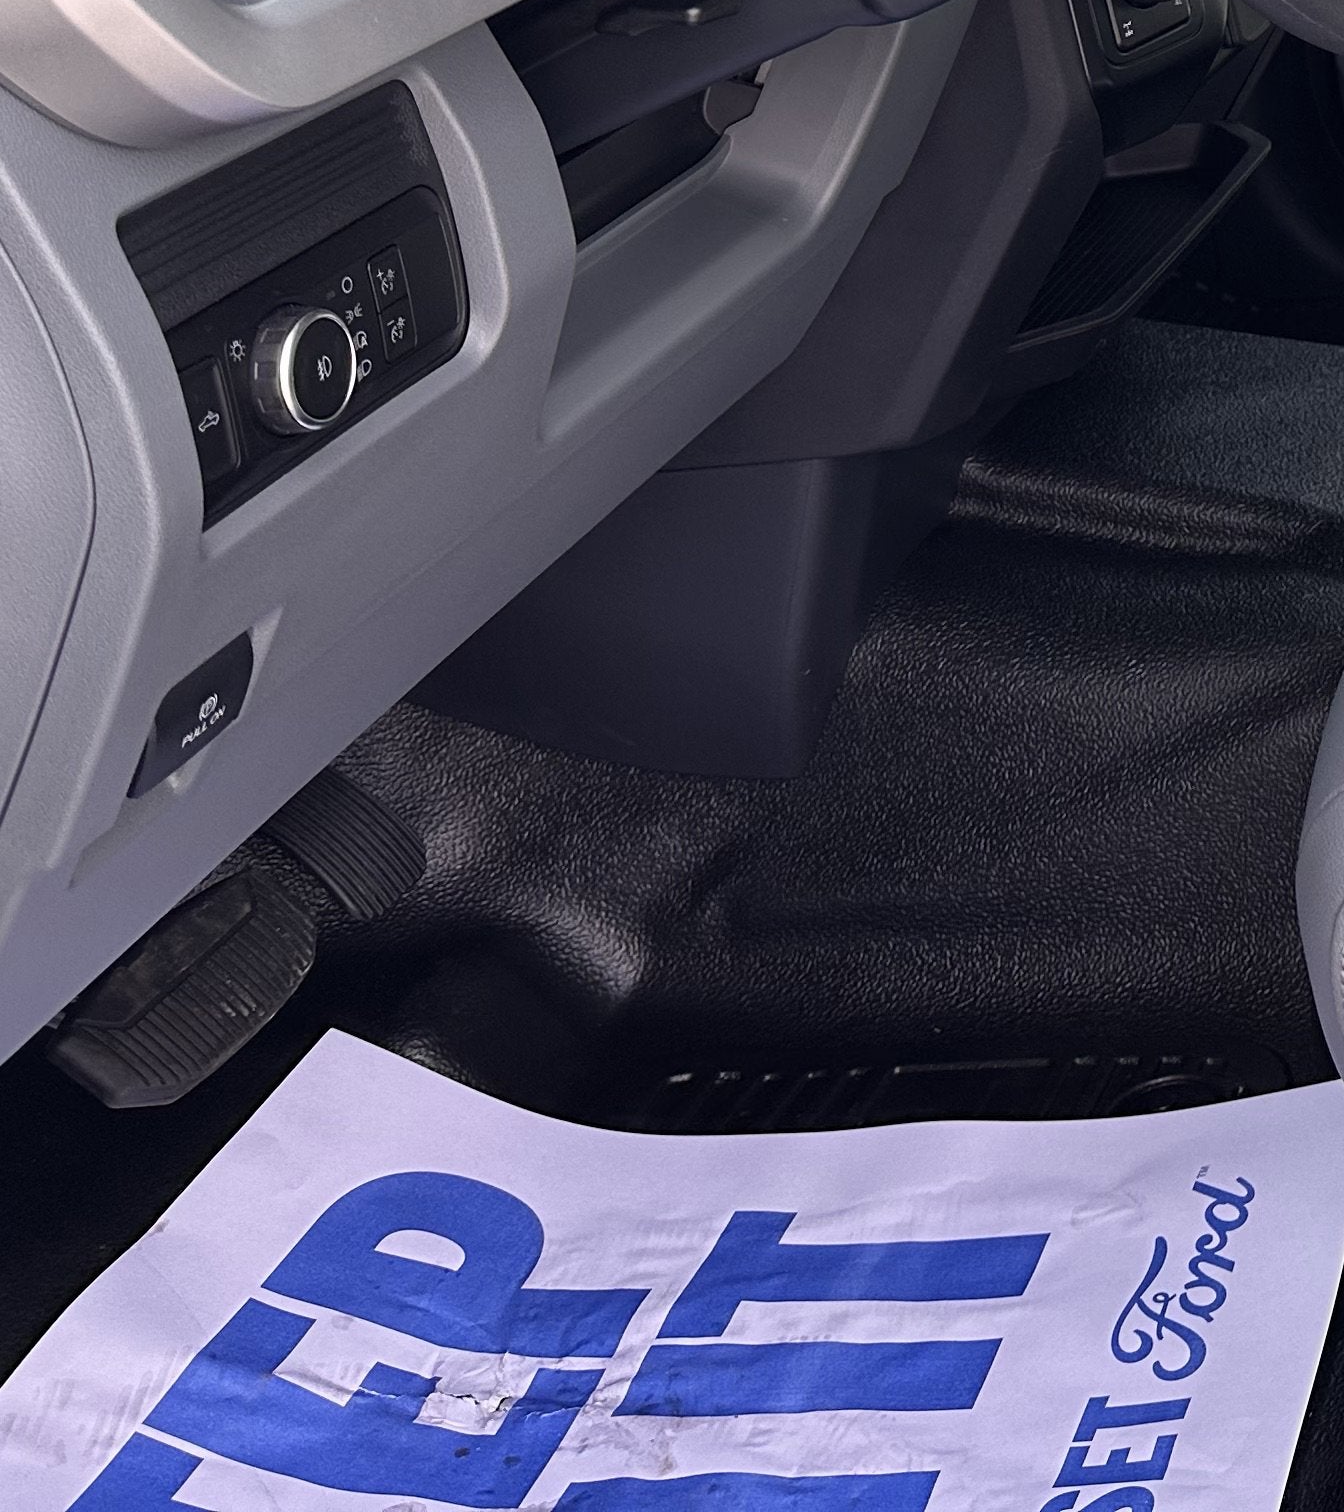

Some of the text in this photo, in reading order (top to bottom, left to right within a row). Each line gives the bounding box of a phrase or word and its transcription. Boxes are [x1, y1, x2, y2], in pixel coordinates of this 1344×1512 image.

[181, 704, 227, 749] PULL ON
[1110, 1176, 1256, 1382] Ford
